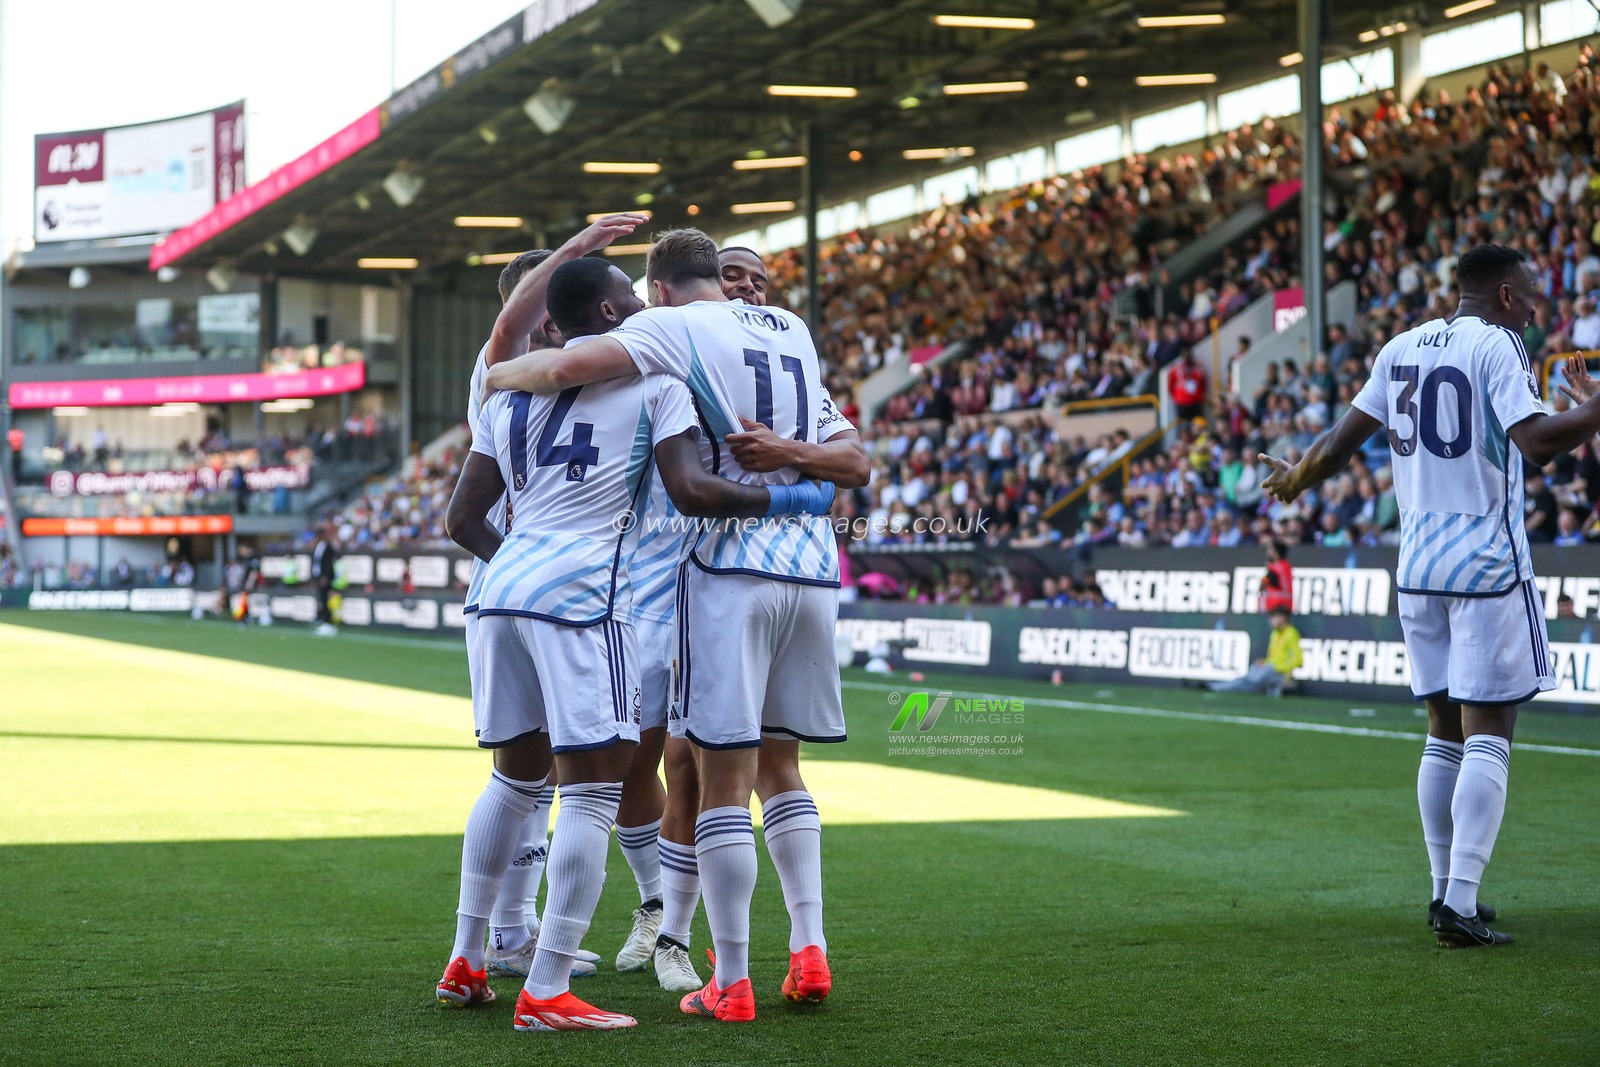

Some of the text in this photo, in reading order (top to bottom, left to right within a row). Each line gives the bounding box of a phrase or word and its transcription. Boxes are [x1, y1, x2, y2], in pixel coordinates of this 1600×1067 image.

[731, 310, 790, 332] WOOD
[743, 347, 809, 443] 11
[1389, 365, 1473, 459] 30
[506, 384, 600, 492] 14
[1018, 626, 1240, 673] SKECHERS FOOTBALL
[1292, 637, 1412, 687] SKECHE
